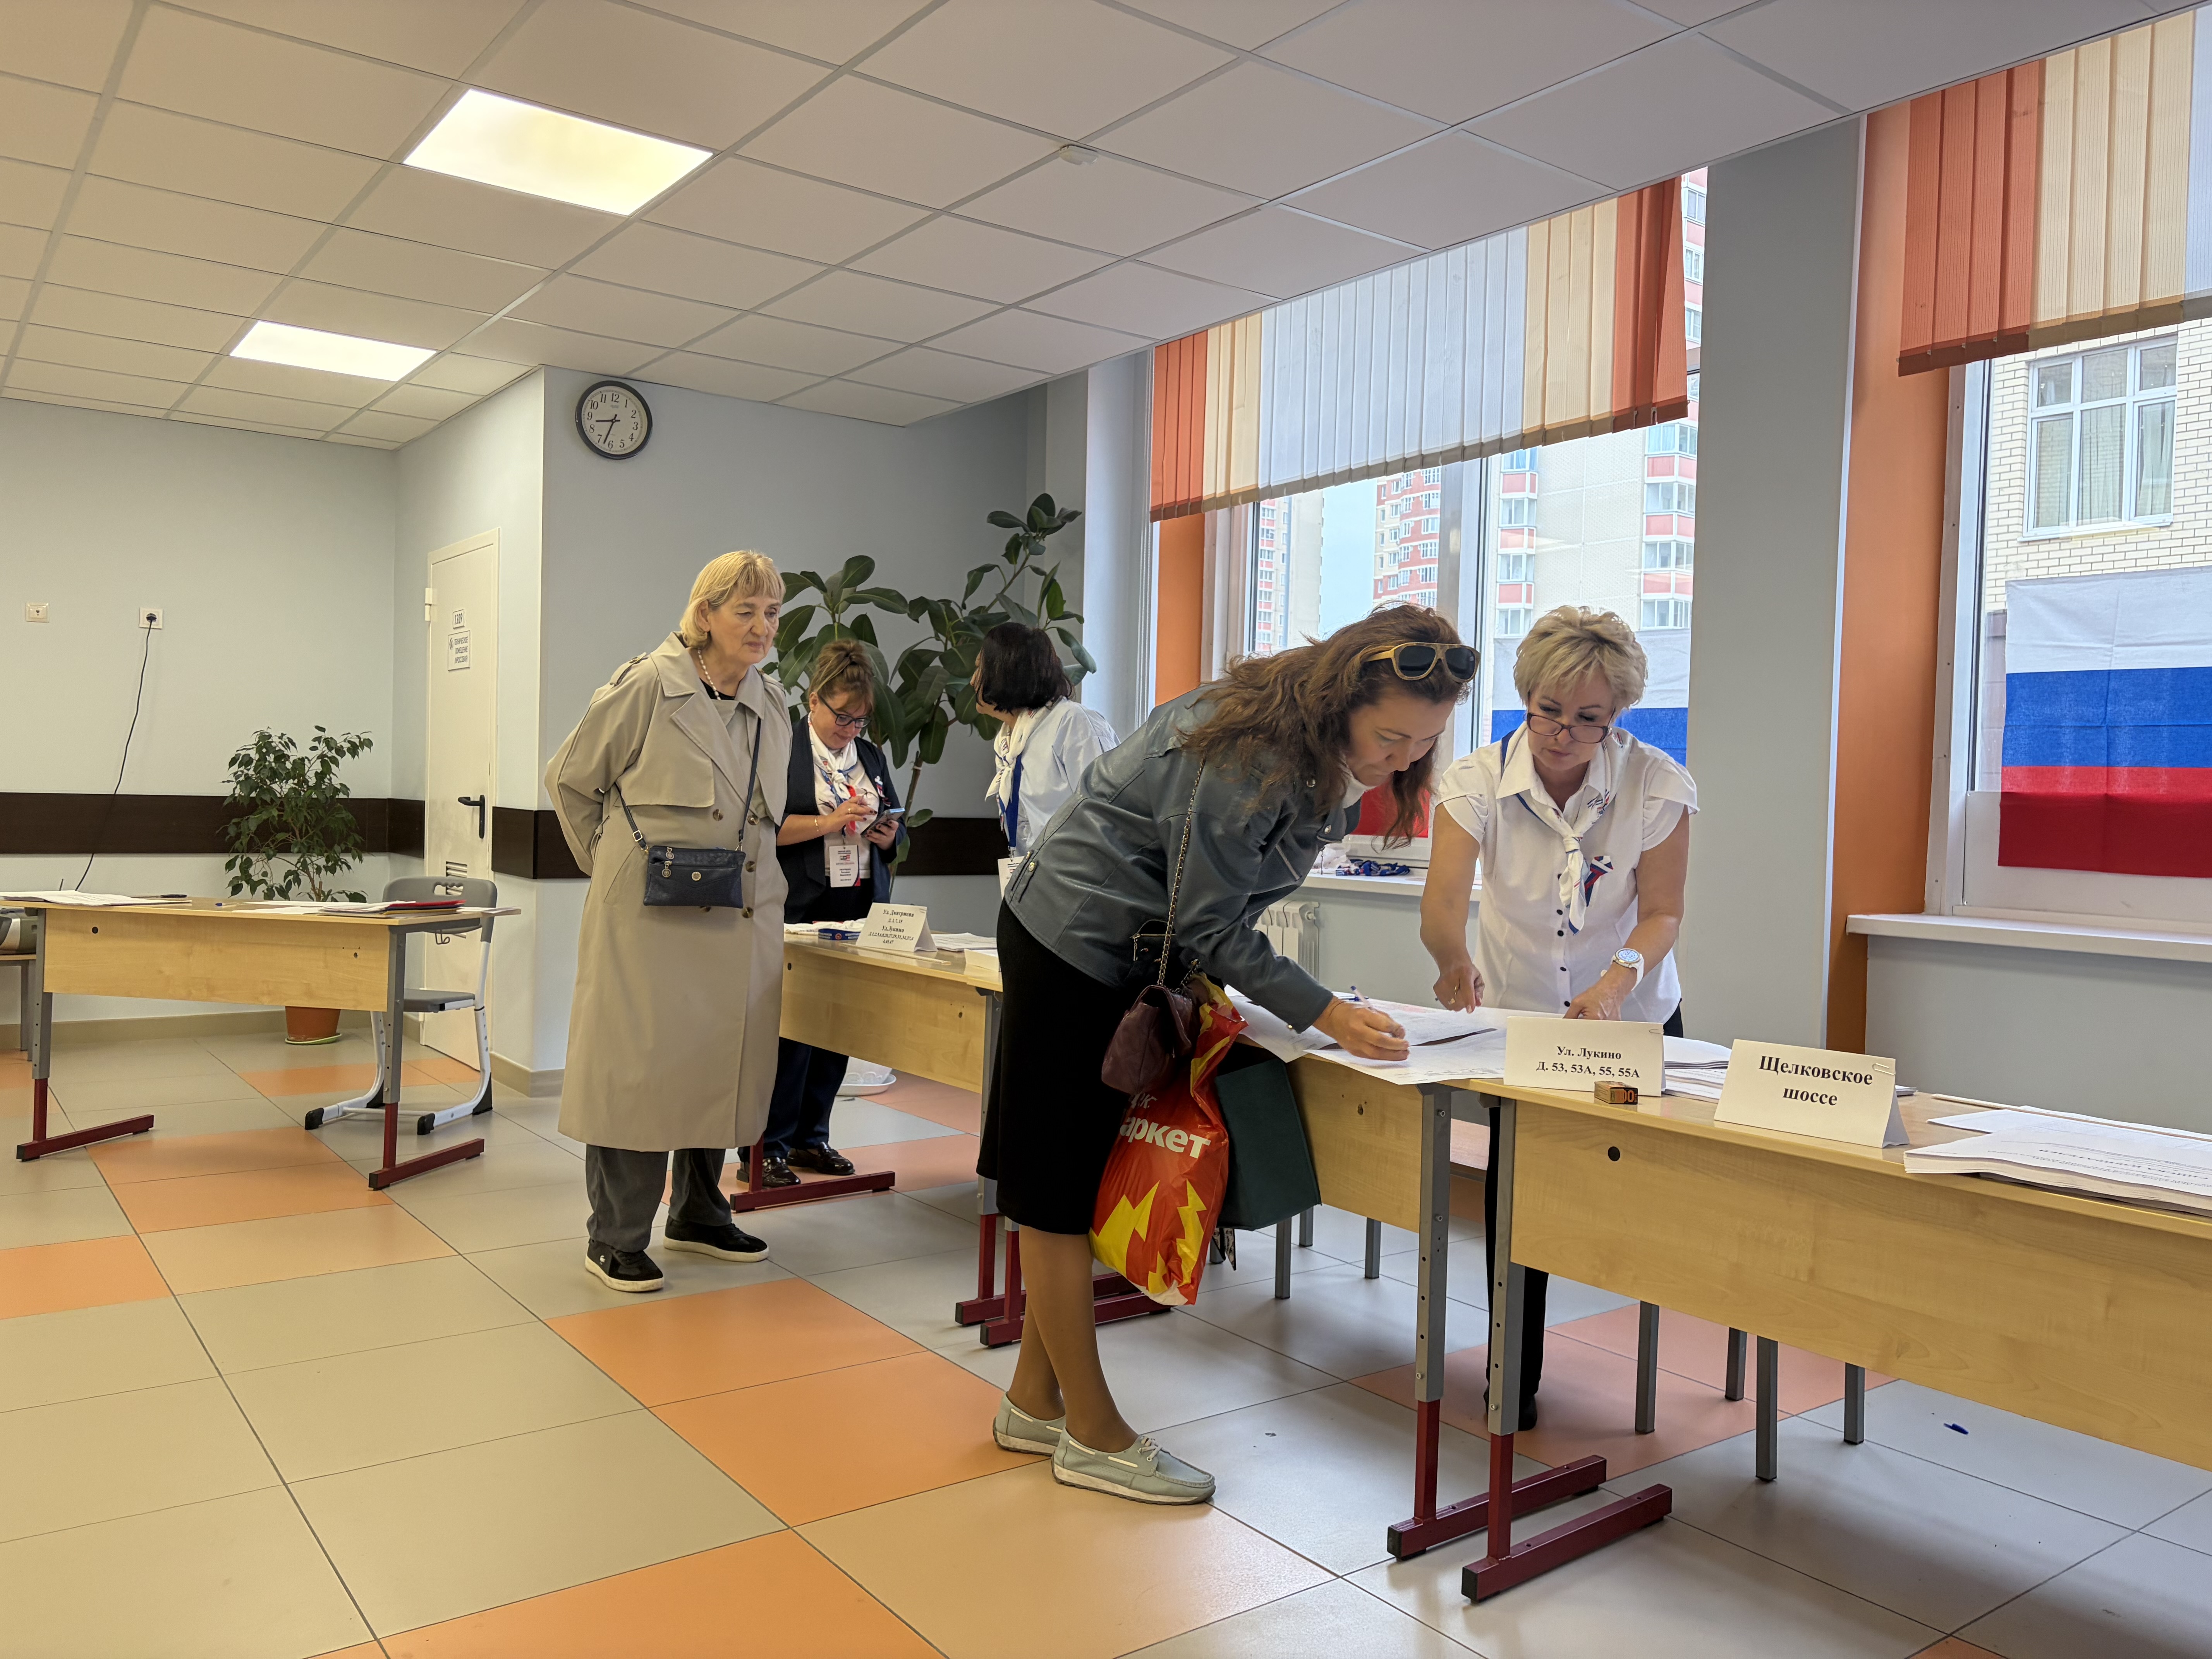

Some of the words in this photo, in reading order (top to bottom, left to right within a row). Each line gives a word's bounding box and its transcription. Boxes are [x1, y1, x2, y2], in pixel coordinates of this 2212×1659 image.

[600, 394, 606, 403] 11
[611, 393, 620, 403] 12
[590, 400, 598, 410] 10
[625, 399, 628, 408] 1
[587, 412, 592, 421] 9
[631, 410, 636, 419] 2
[589, 424, 595, 433] 8
[632, 422, 638, 431] 3
[597, 434, 603, 443] 7
[629, 433, 634, 441] 4
[608, 440, 613, 449] 6
[619, 440, 625, 448] 5
[1557, 1046, 1574, 1056] Ул.
[1578, 1048, 1621, 1060] Лукино
[1536, 1061, 1548, 1072] Д.
[1552, 1063, 1567, 1073] 53,
[1571, 1064, 1595, 1076] 53А,
[1599, 1066, 1614, 1077] 55,
[1618, 1068, 1640, 1078] 55А
[1759, 1056, 1873, 1085] Щелковское
[1783, 1088, 1838, 1106] шоссе
[1120, 1116, 1211, 1159] аркет
